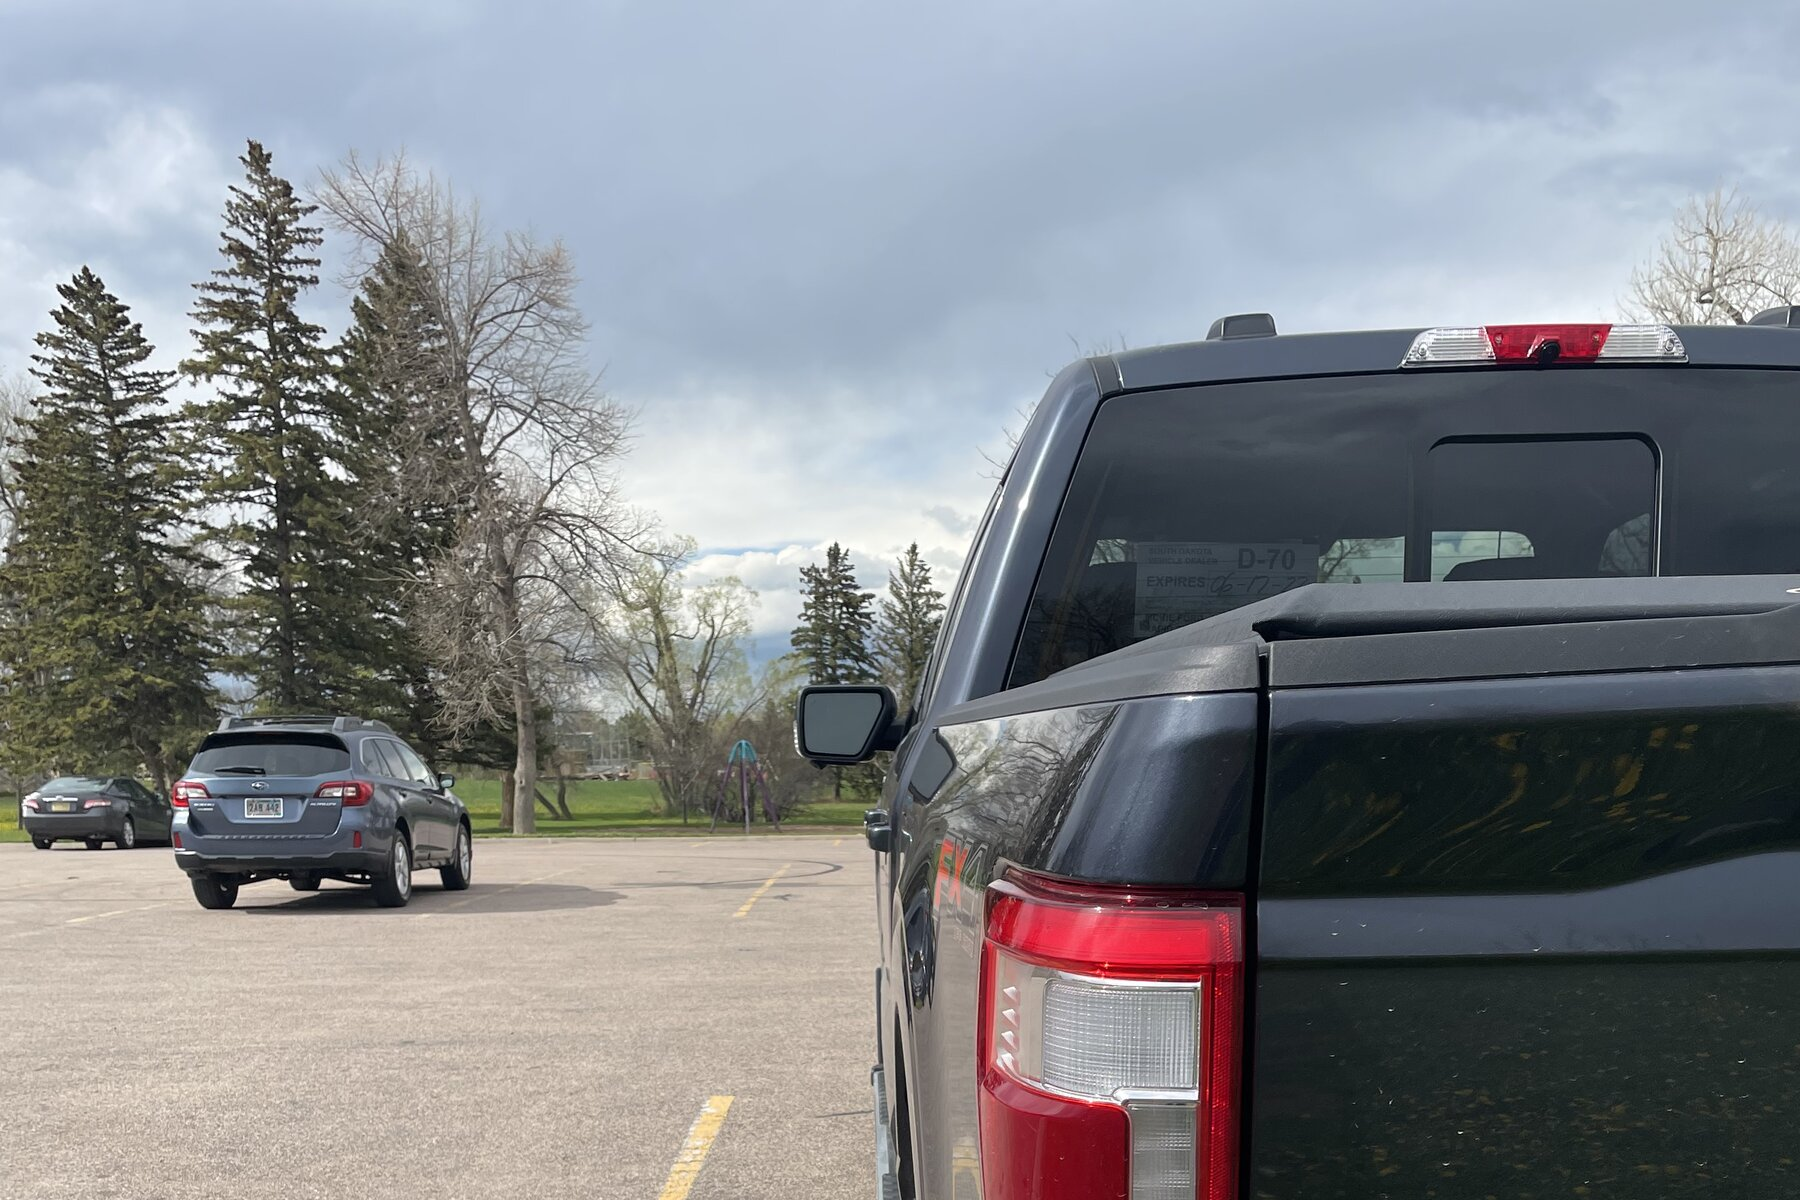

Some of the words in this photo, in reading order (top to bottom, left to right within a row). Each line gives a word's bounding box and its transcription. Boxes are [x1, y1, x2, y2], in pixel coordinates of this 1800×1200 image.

[1238, 549, 1295, 570] D-70
[1147, 576, 1205, 588] EXPIRES
[932, 829, 988, 936] FX4
